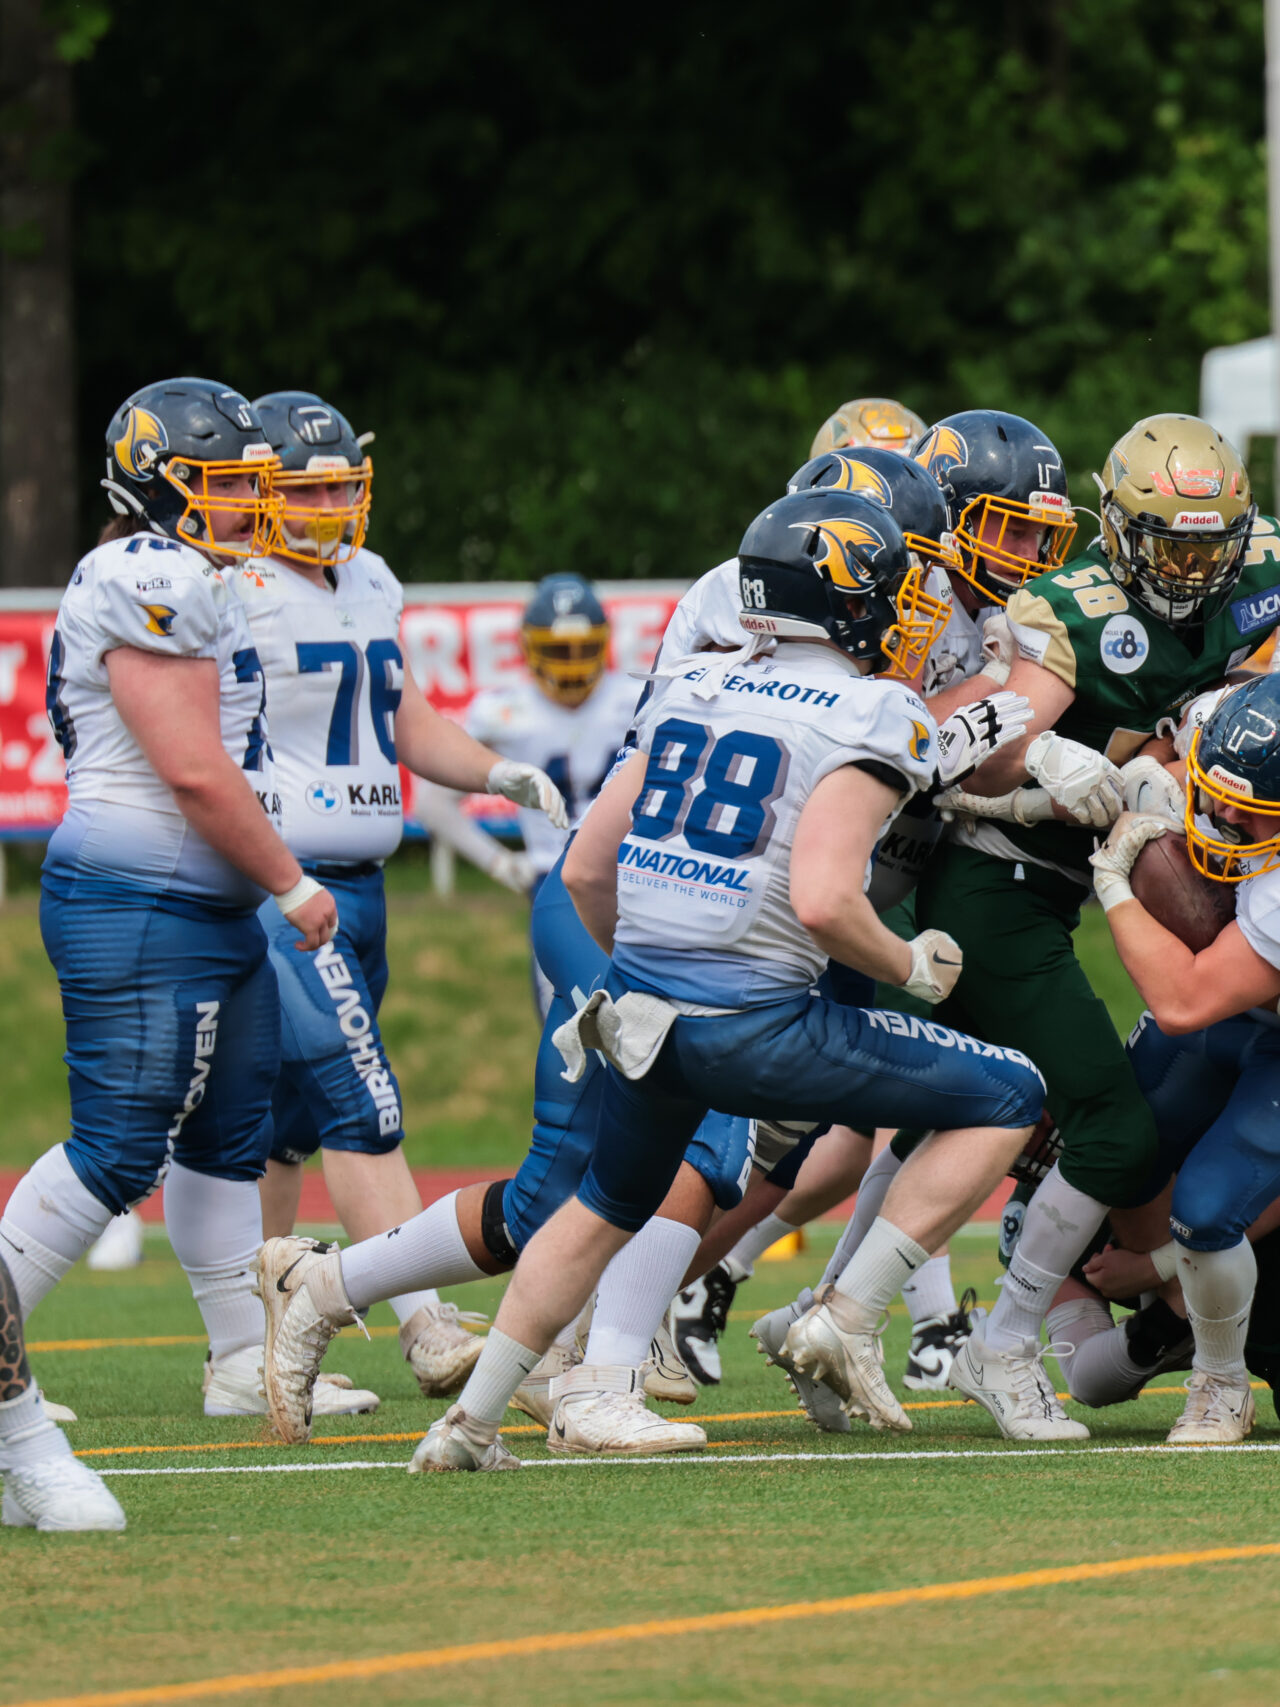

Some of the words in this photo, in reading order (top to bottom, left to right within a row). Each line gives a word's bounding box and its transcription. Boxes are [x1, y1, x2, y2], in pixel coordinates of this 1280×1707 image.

[1180, 514, 1219, 526] Riddell
[742, 577, 767, 609] 88
[1051, 564, 1130, 620] 58
[295, 639, 404, 767] 76
[629, 717, 792, 860] 88
[1211, 768, 1249, 793] Riddell
[622, 872, 669, 891] DELIVER
[672, 881, 695, 898] THE
[699, 888, 746, 910] WORLD
[624, 843, 750, 893] NATIONAL
[314, 940, 401, 1137] BIRKHOVEN
